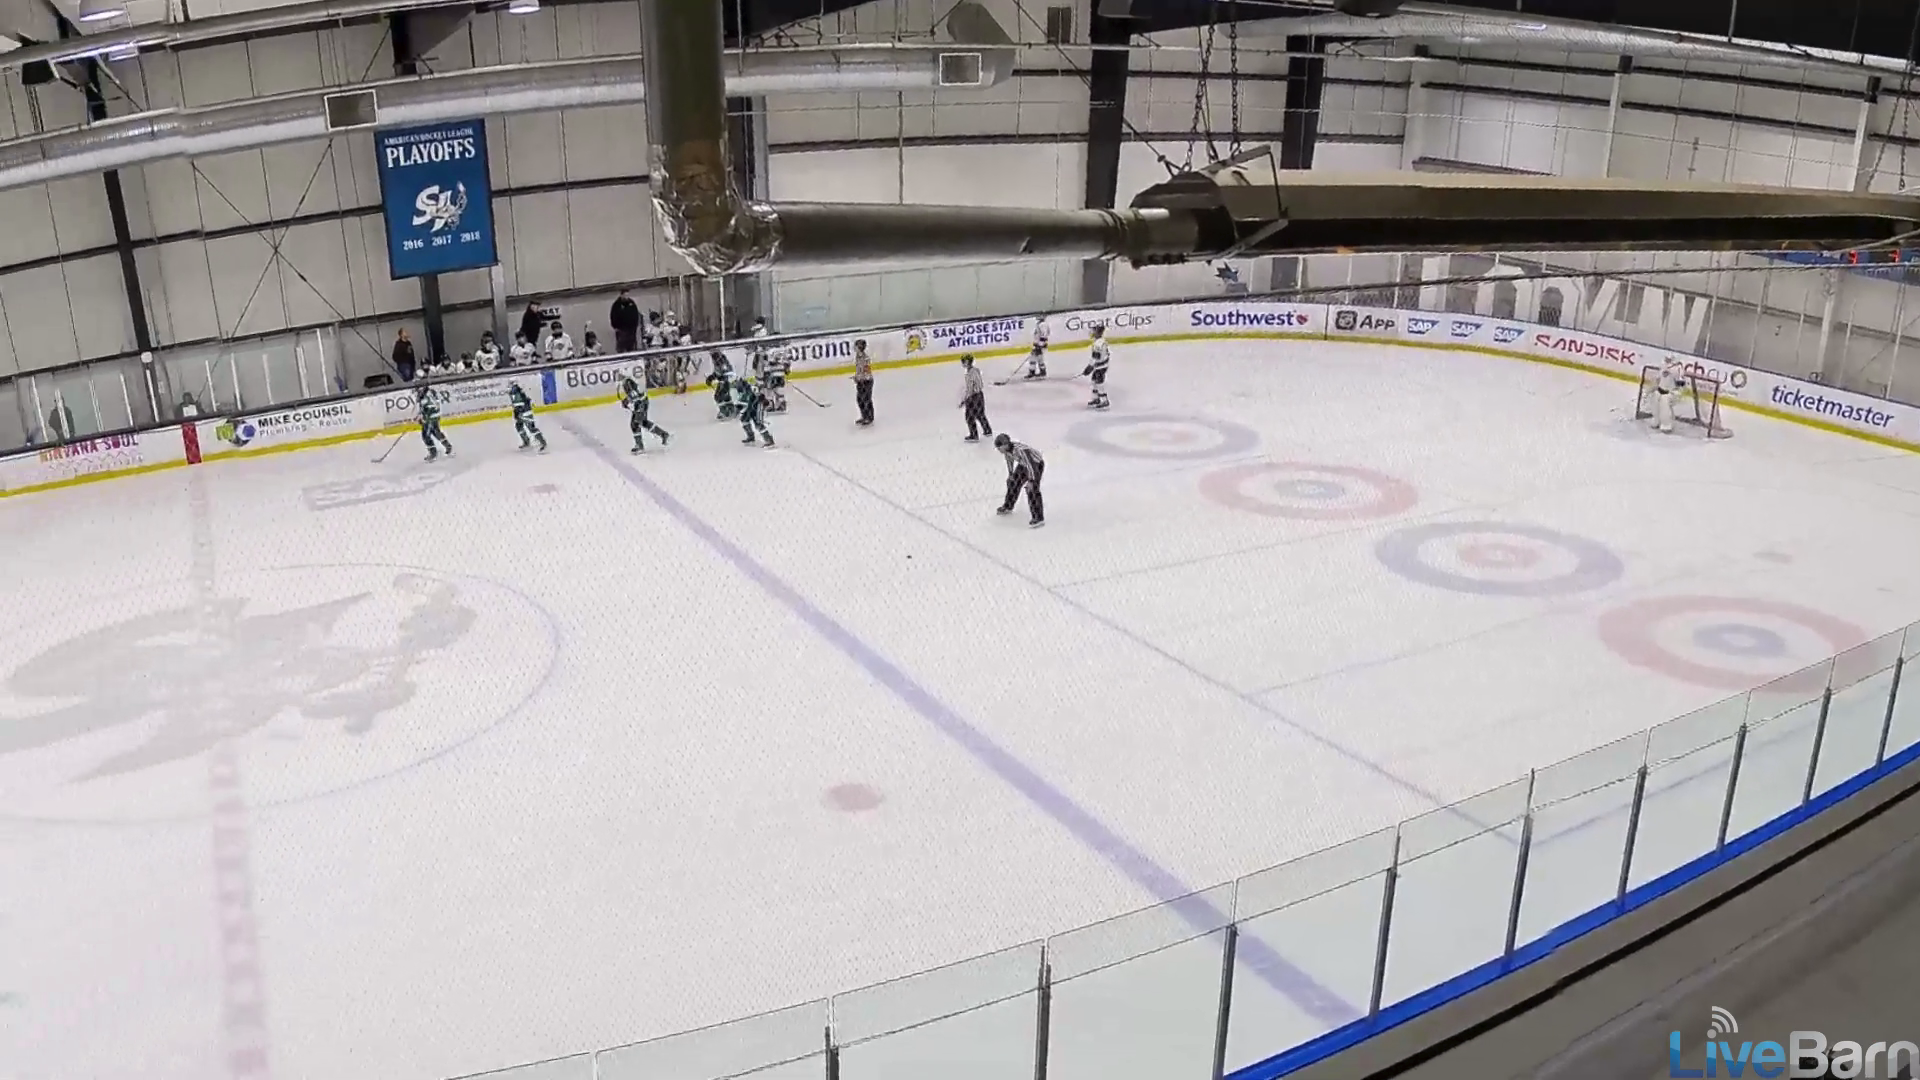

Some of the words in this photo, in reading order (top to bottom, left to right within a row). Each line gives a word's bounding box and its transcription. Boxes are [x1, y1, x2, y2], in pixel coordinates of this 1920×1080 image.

[386, 137, 475, 168] PLAYOFFS
[402, 238, 424, 251] 2016
[432, 234, 452, 247] 2017
[459, 230, 481, 243] 2018
[1115, 312, 1152, 330] Clips
[1191, 308, 1294, 327] Southwest
[1408, 319, 1434, 332] SAP
[932, 326, 957, 339] SAN
[958, 322, 989, 336] JOSE
[991, 319, 1025, 332] STATE
[1451, 322, 1477, 335] SAP
[1494, 328, 1520, 341] SAP
[947, 331, 1010, 349] ATHLETICS
[787, 340, 851, 362] orona
[1771, 384, 1895, 428] ticketmaster
[258, 413, 291, 427] MIKE
[292, 405, 352, 422] COUNSIL
